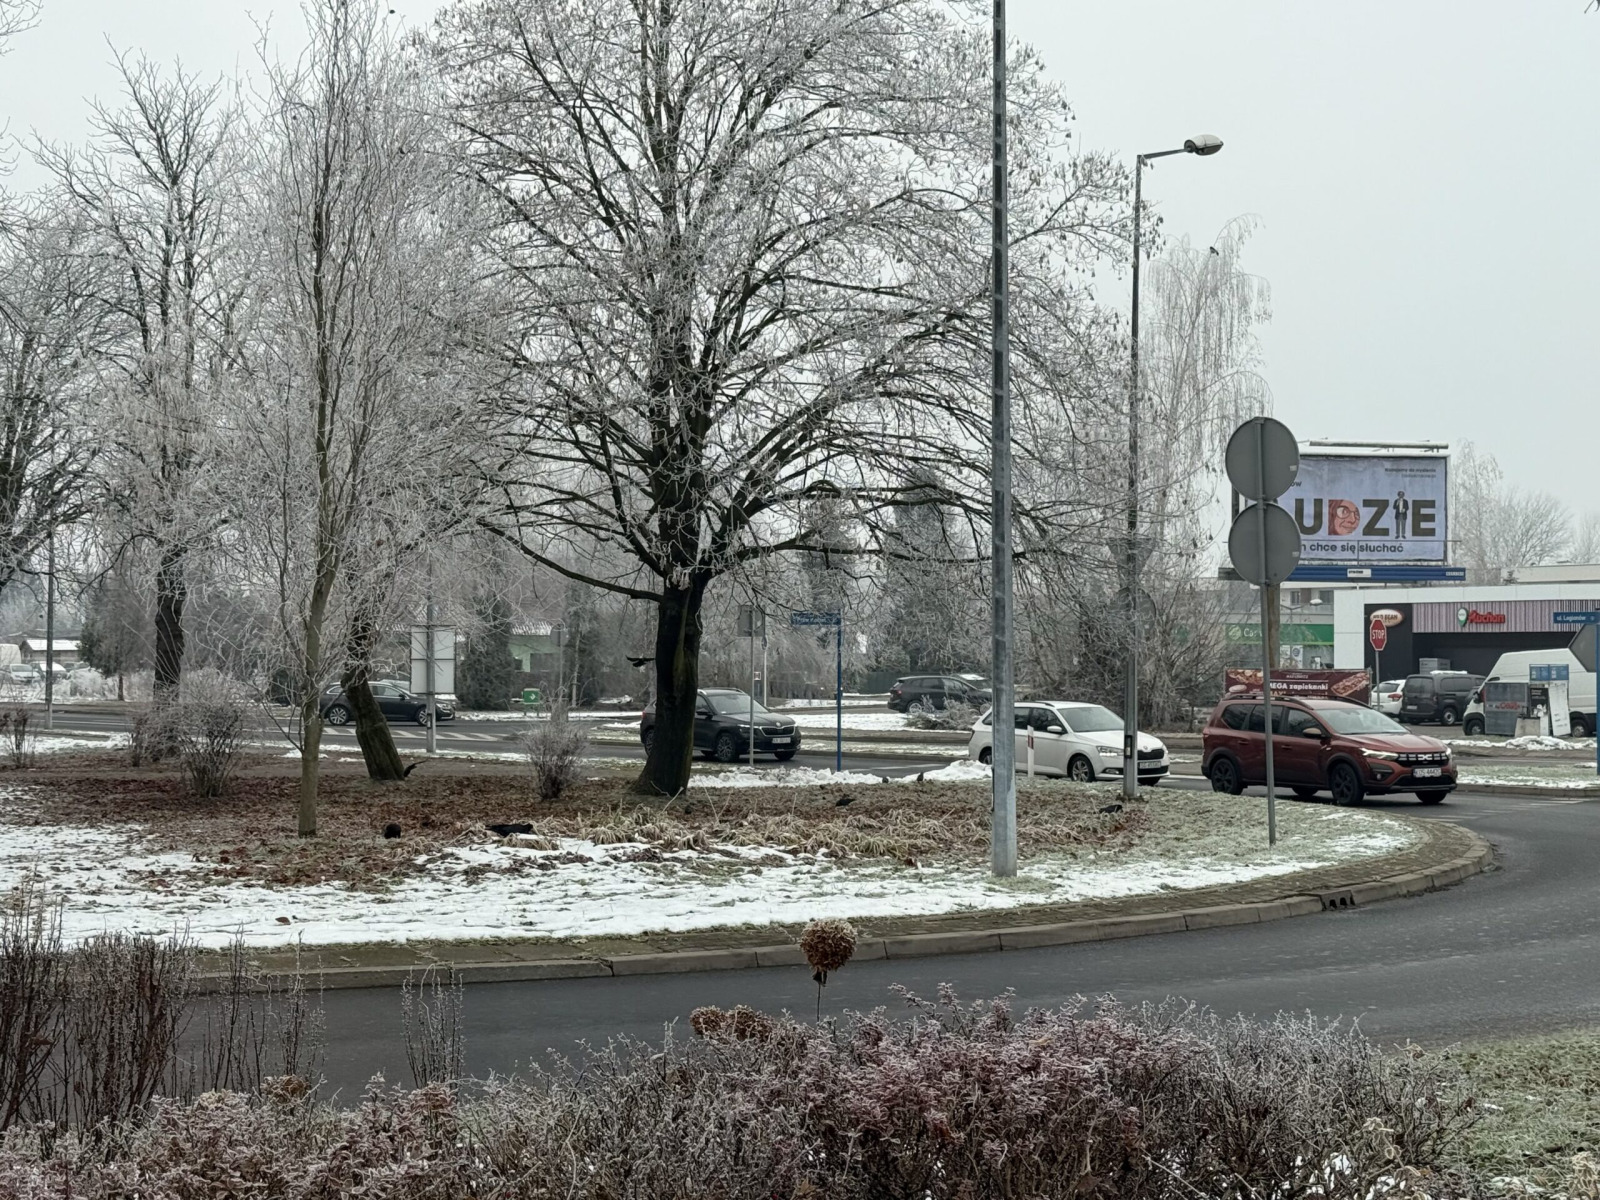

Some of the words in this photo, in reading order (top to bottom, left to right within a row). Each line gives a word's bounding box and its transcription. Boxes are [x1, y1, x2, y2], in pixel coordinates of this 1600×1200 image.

[1294, 498, 1436, 538] UDZIE
[1309, 542, 1338, 552] chce
[1340, 542, 1356, 554] się
[1359, 542, 1404, 553] słuchać
[1468, 610, 1505, 624] Auchan
[1372, 629, 1385, 640] STOP
[1289, 683, 1329, 691] zapiekanki
